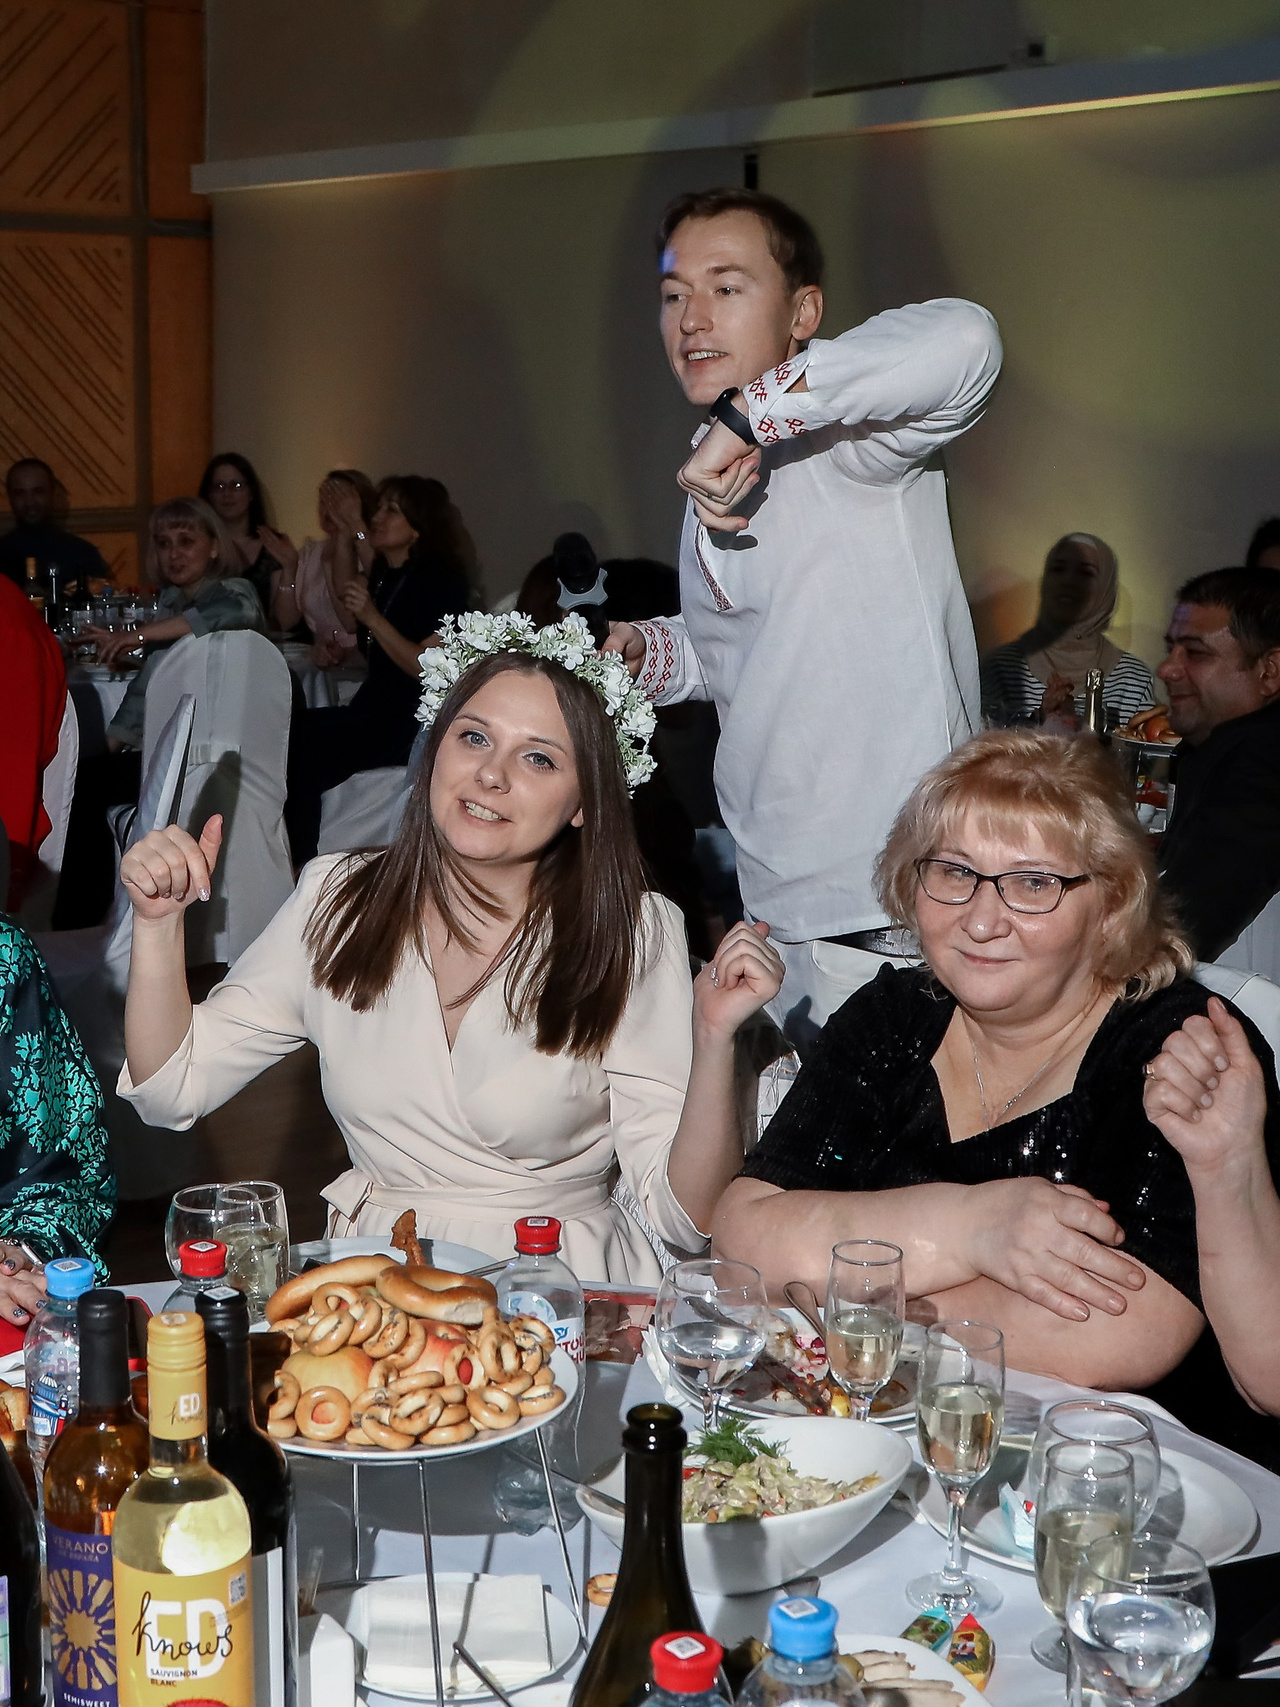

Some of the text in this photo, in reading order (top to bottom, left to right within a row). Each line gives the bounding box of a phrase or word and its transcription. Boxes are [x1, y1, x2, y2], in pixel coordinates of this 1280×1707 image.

[179, 1393, 201, 1418] ED
[53, 1534, 109, 1555] VERANO
[132, 1590, 234, 1661] knows
[145, 1598, 229, 1681] ED
[150, 1668, 198, 1678] SAUVIGNON
[150, 1679, 178, 1687] BLANC
[63, 1692, 111, 1707] SEMISWEET
